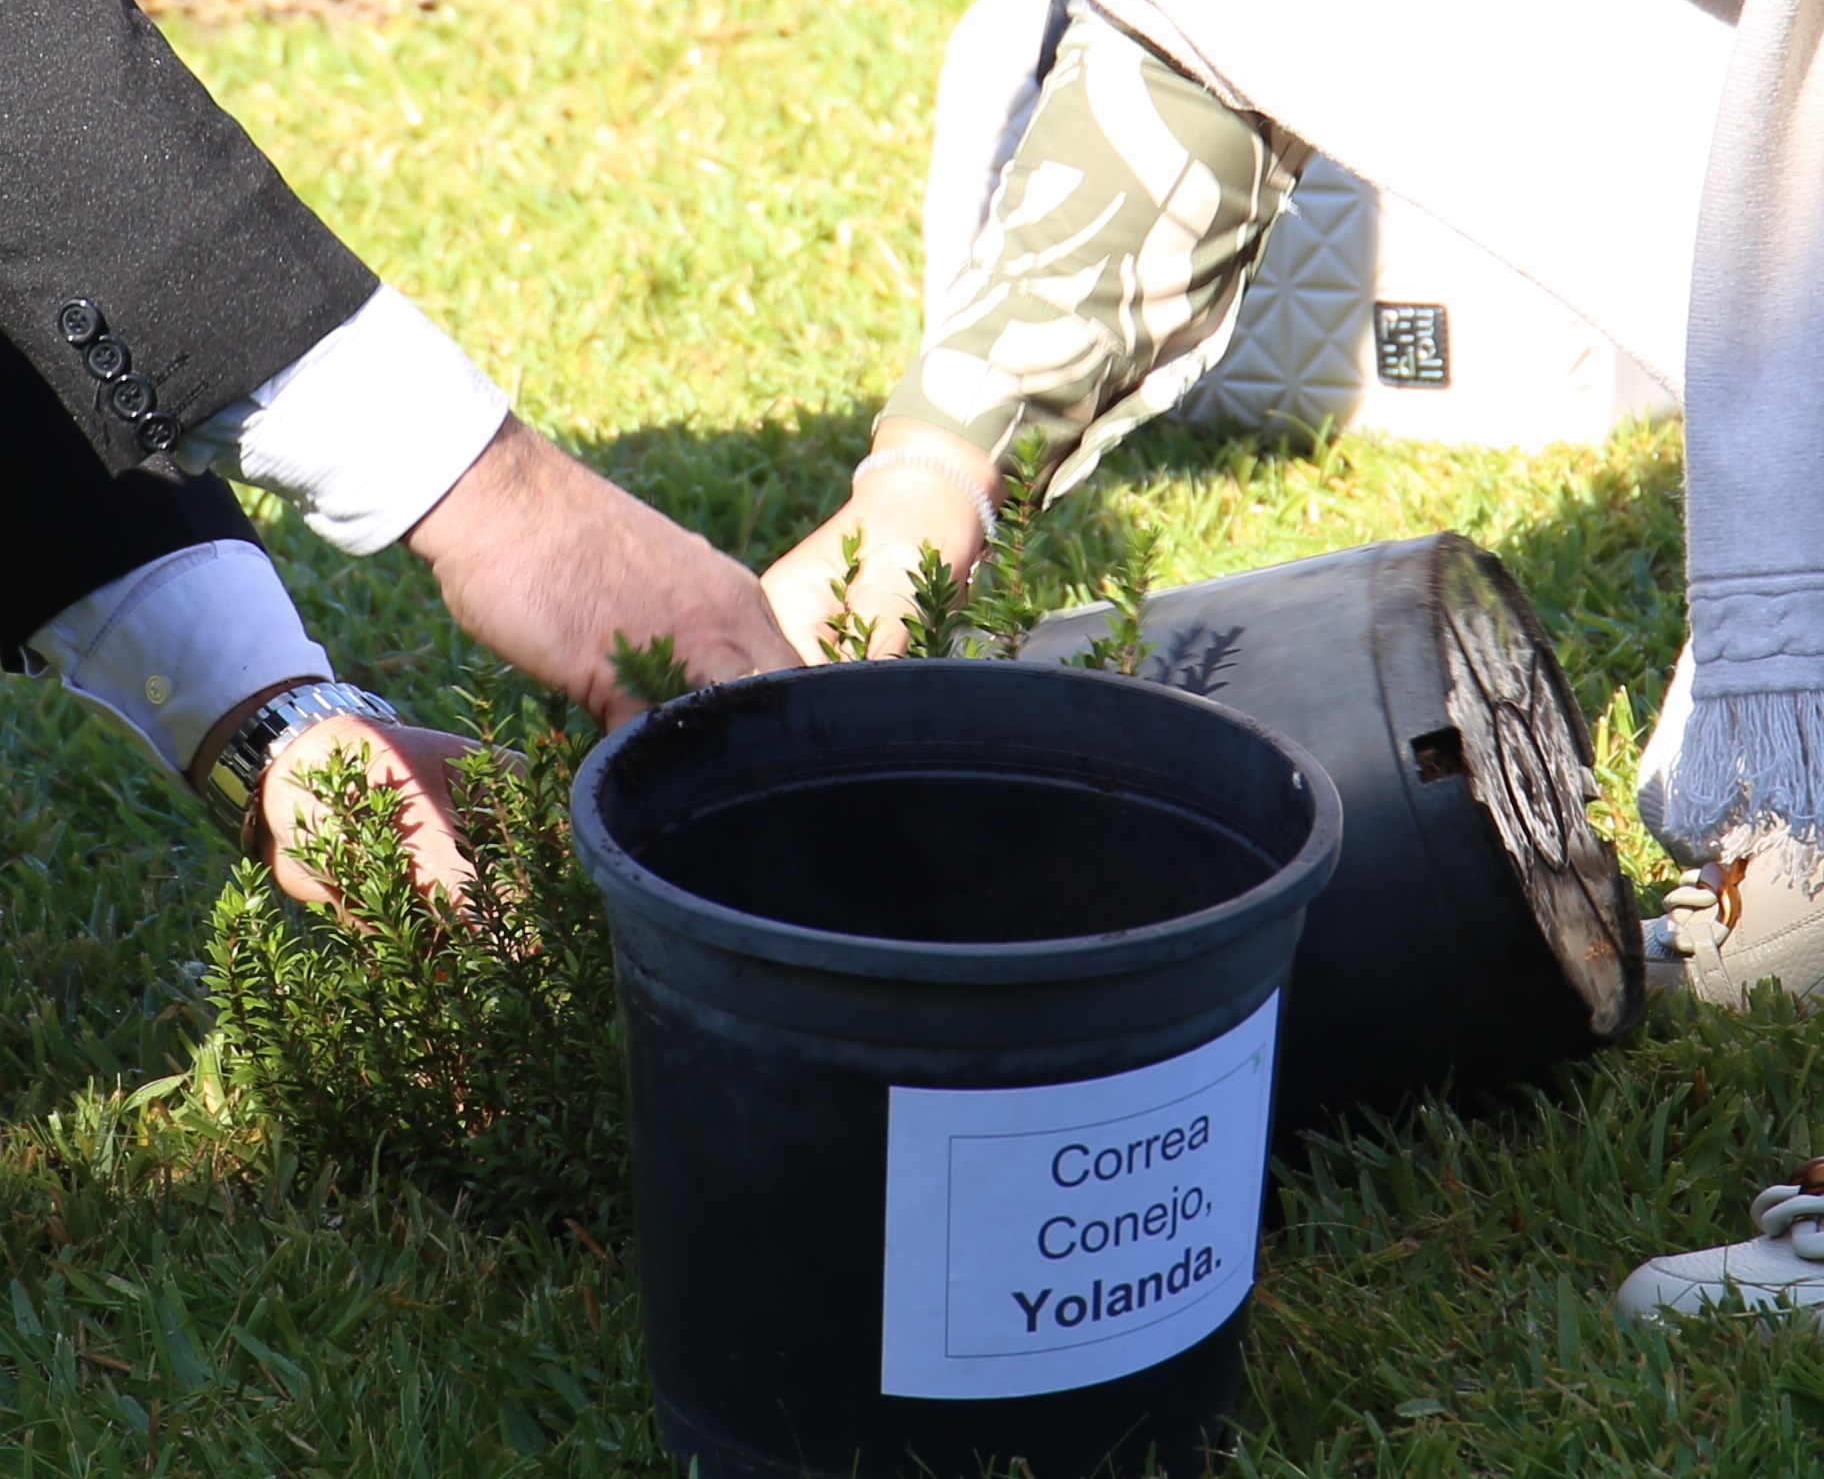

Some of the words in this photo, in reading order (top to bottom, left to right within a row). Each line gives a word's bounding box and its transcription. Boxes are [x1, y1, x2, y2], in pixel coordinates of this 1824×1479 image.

[1051, 1114, 1210, 1188] Correa
[1037, 1186, 1213, 1260] Conejo,
[1011, 1245, 1223, 1333] Yolanda.
